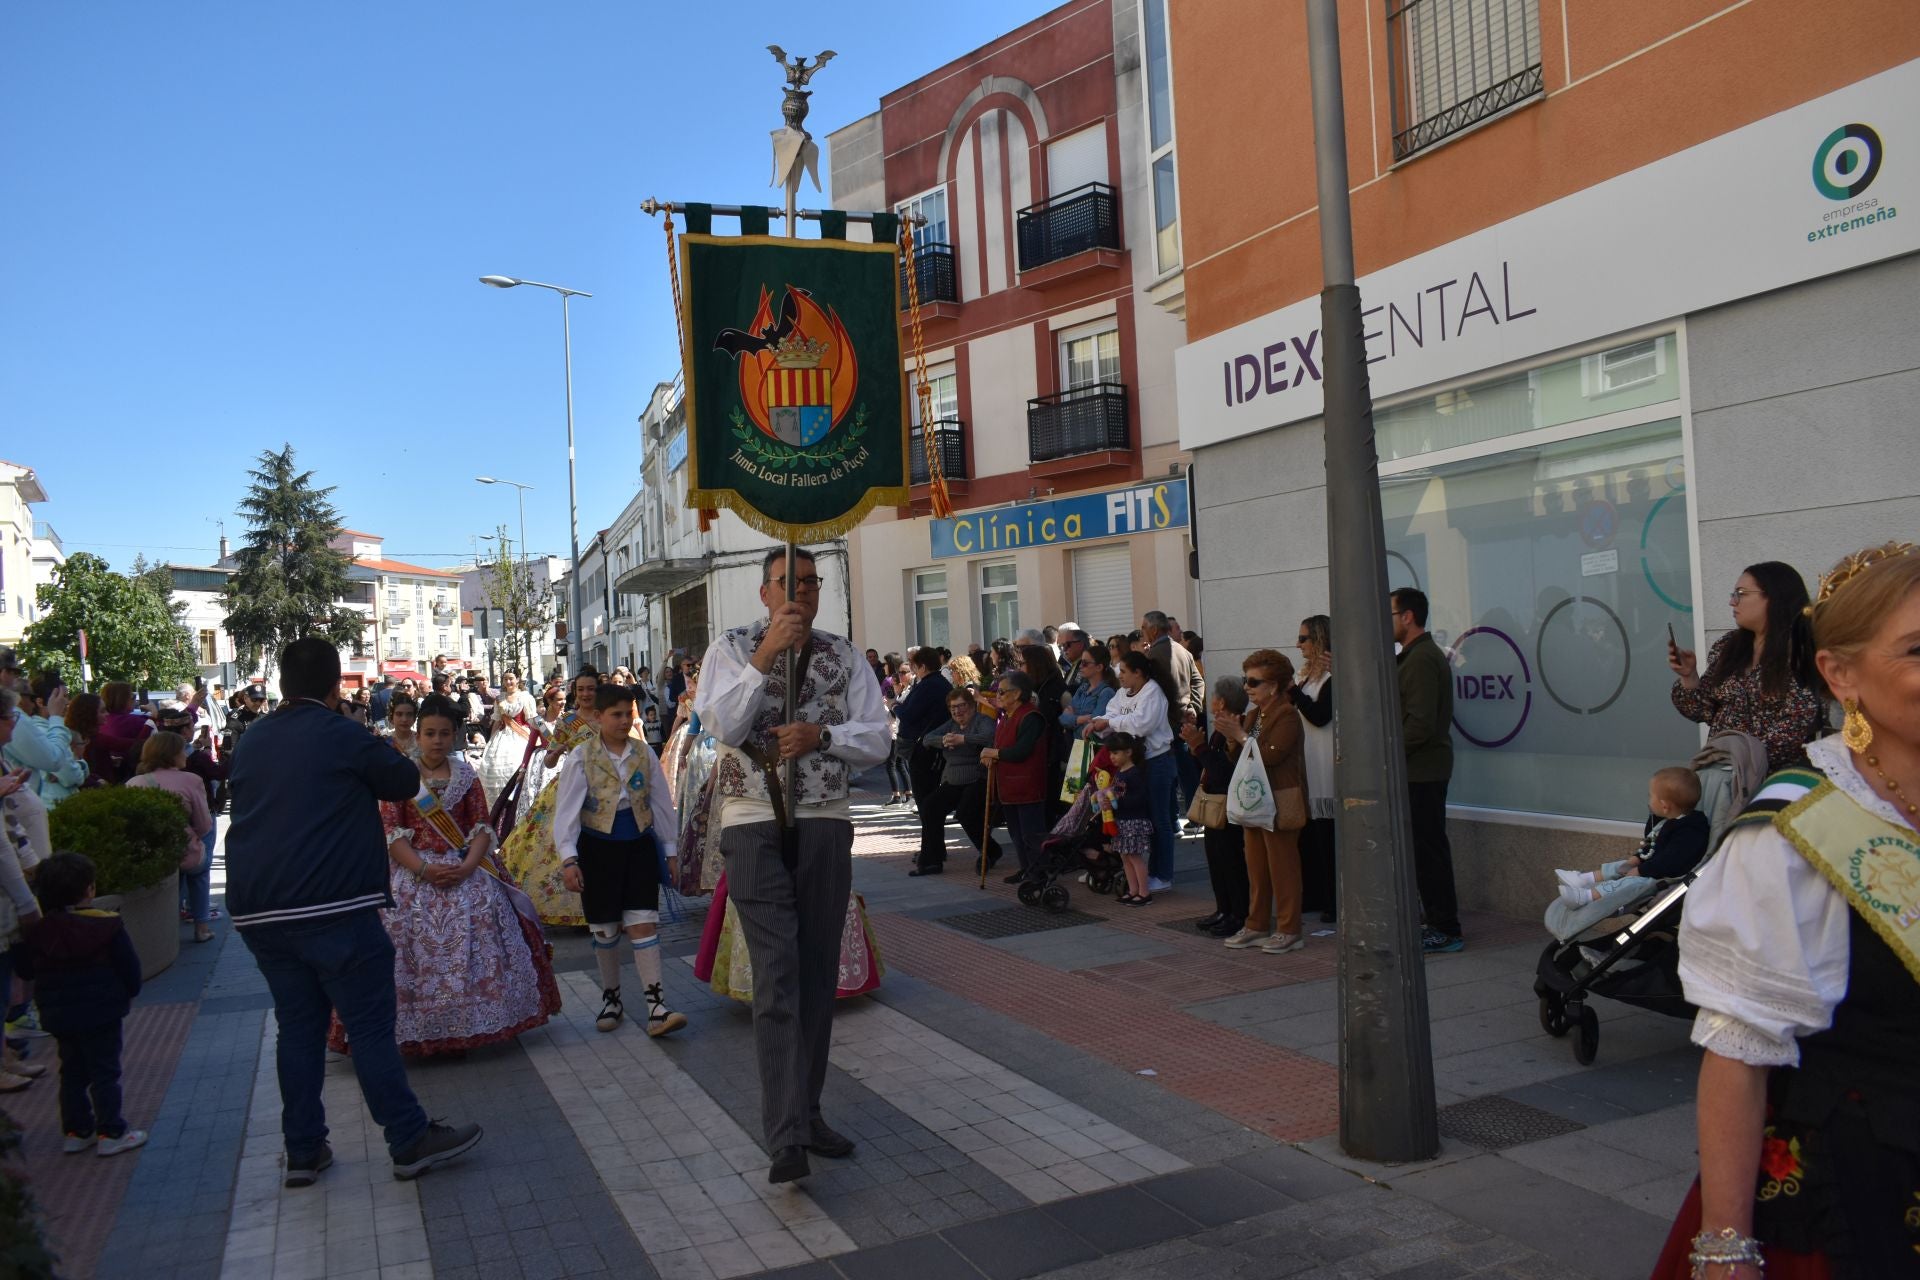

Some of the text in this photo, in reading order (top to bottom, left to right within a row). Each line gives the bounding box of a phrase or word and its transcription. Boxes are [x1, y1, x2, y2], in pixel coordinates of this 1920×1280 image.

[1807, 206, 1897, 243] extremeña
[1822, 198, 1878, 222] empresa
[1361, 261, 1537, 365] ENTAL
[729, 446, 869, 487] Junta Local Fallera de Puçol
[953, 484, 1171, 552] Clínica FITS
[1456, 675, 1515, 700] IDEX
[1848, 847, 1901, 914] ASOCIACIÓN
